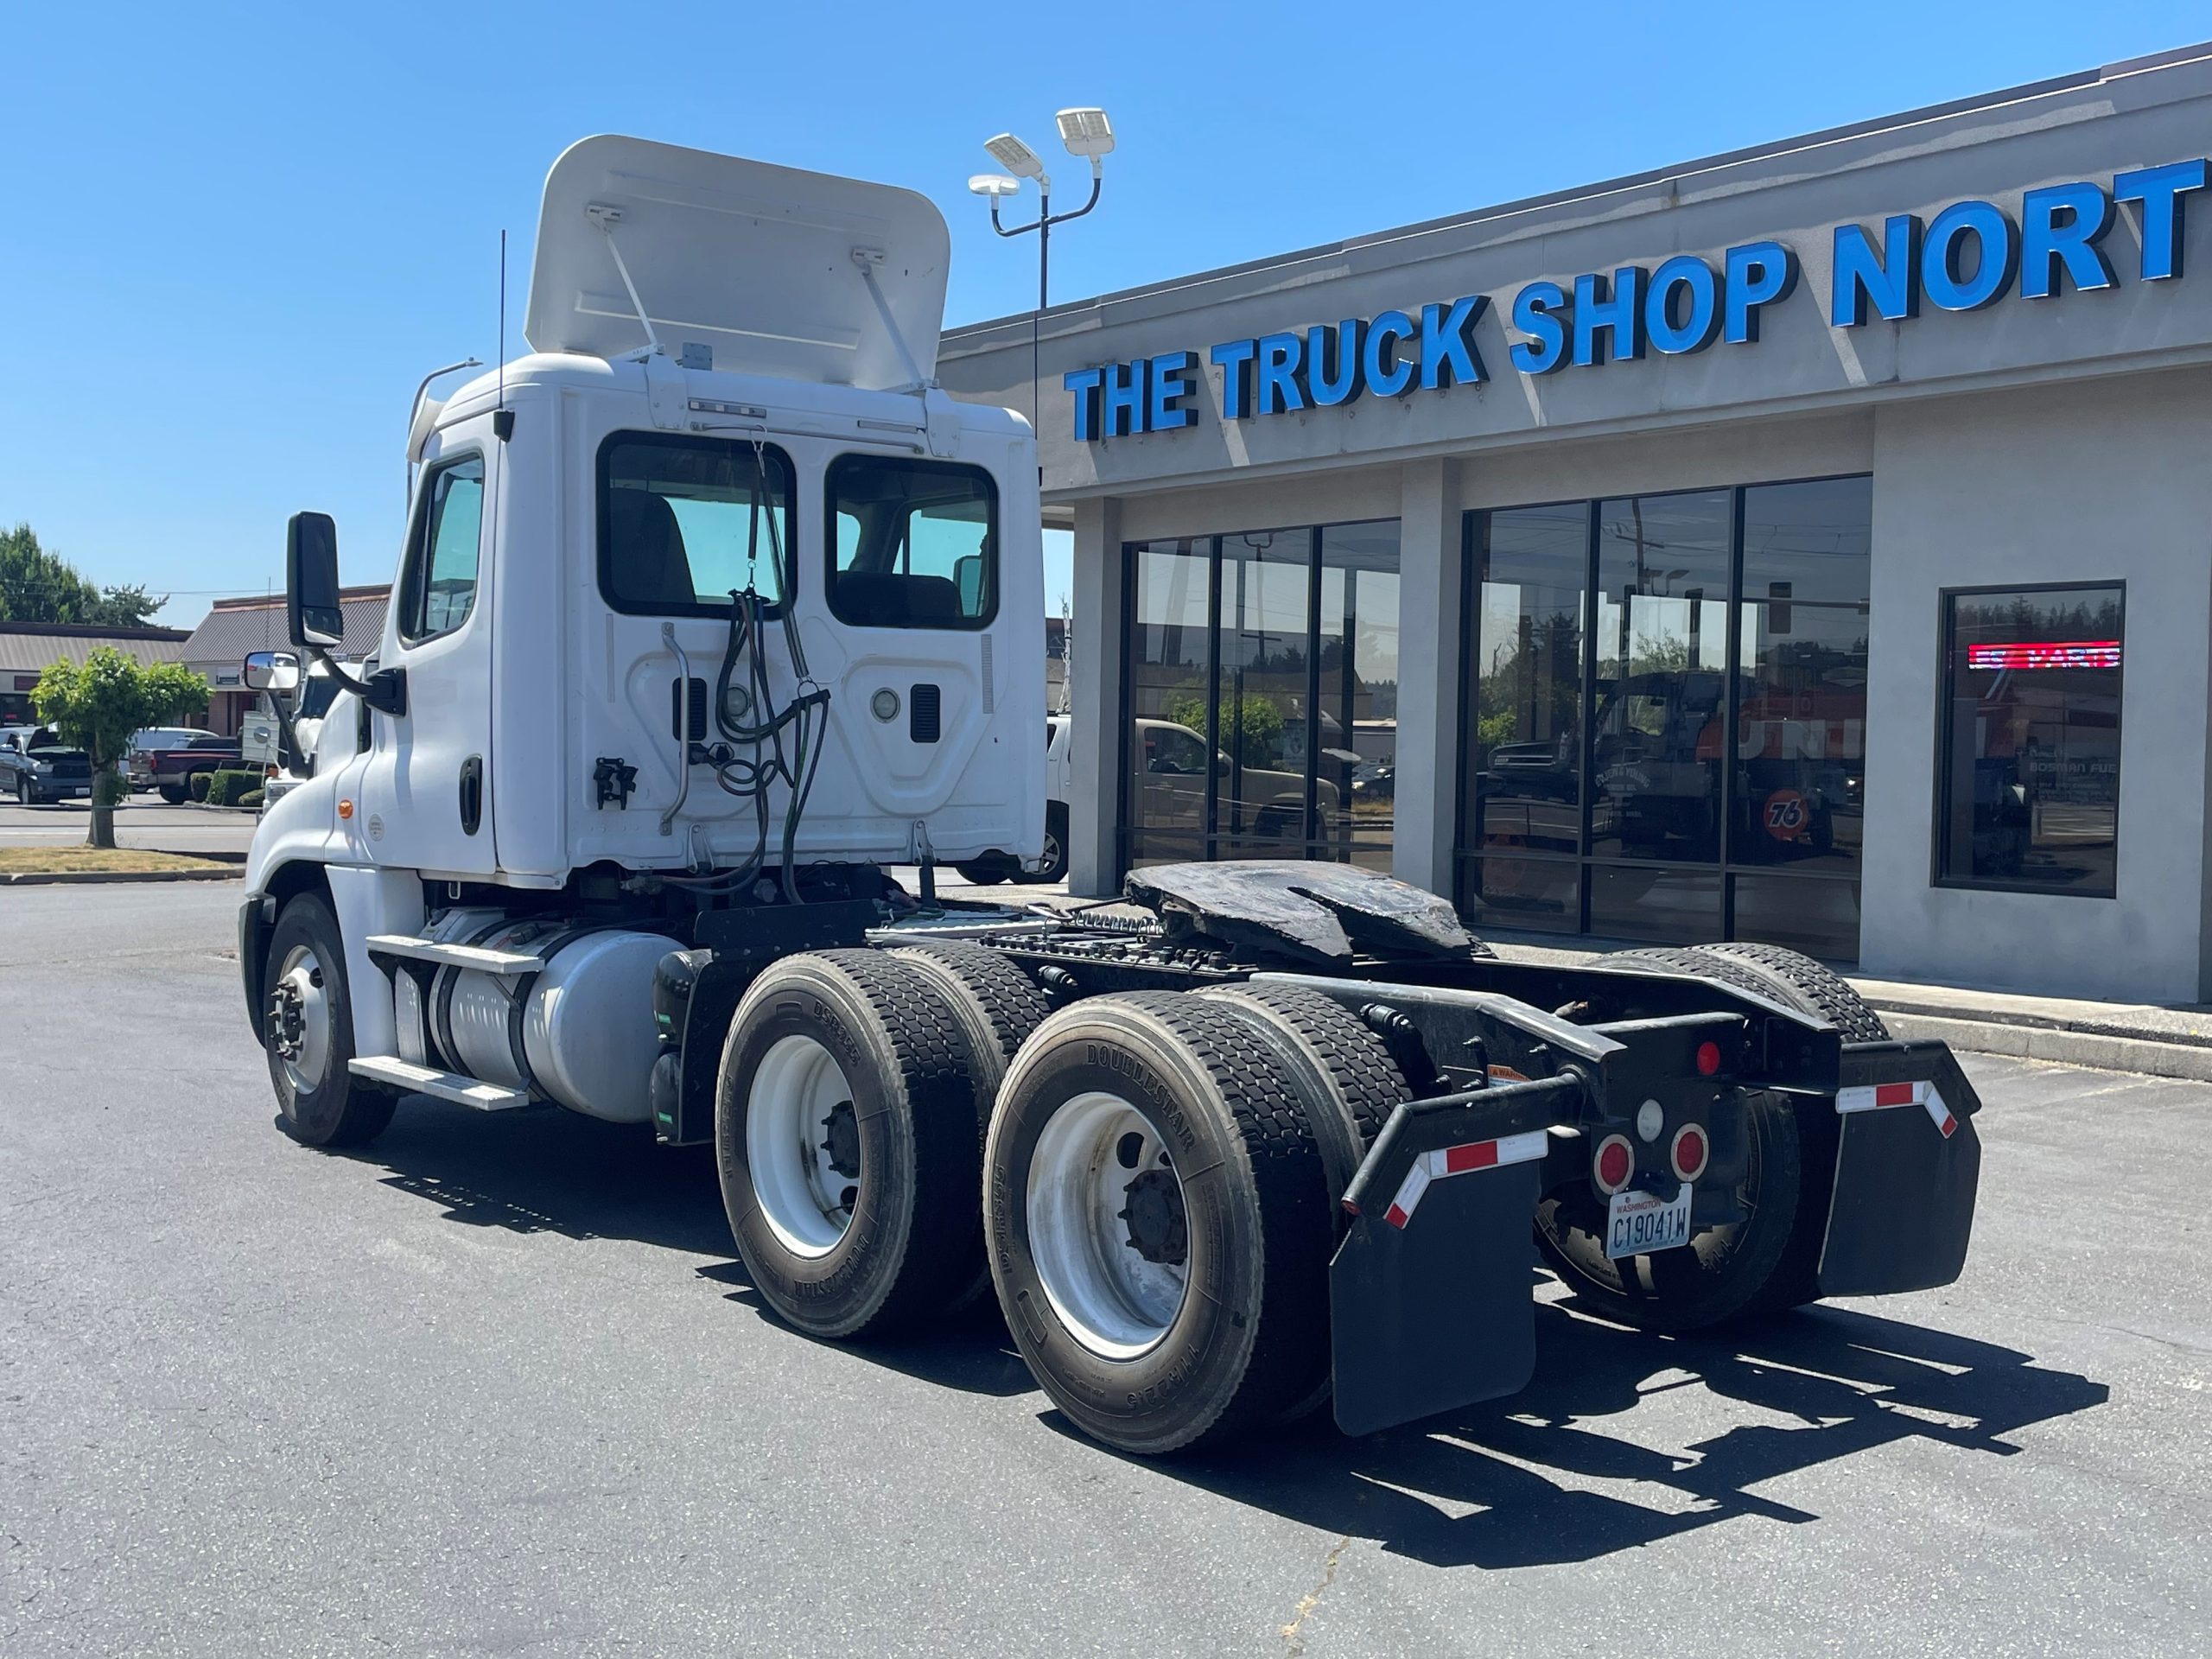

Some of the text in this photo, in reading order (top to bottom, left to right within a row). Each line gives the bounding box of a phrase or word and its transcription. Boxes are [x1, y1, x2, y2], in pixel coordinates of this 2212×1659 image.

[1064, 157, 2212, 442] THE TRUCK SHOP NORT
[2030, 762, 2086, 773] BOSMAN
[1768, 798, 1803, 829] 76
[1085, 1044, 1196, 1155] DOUBLESTAR
[1616, 1198, 1662, 1214] WASHINGTON
[1613, 1207, 1688, 1249] C19041W
[1126, 1342, 1200, 1411] 11R22.5
